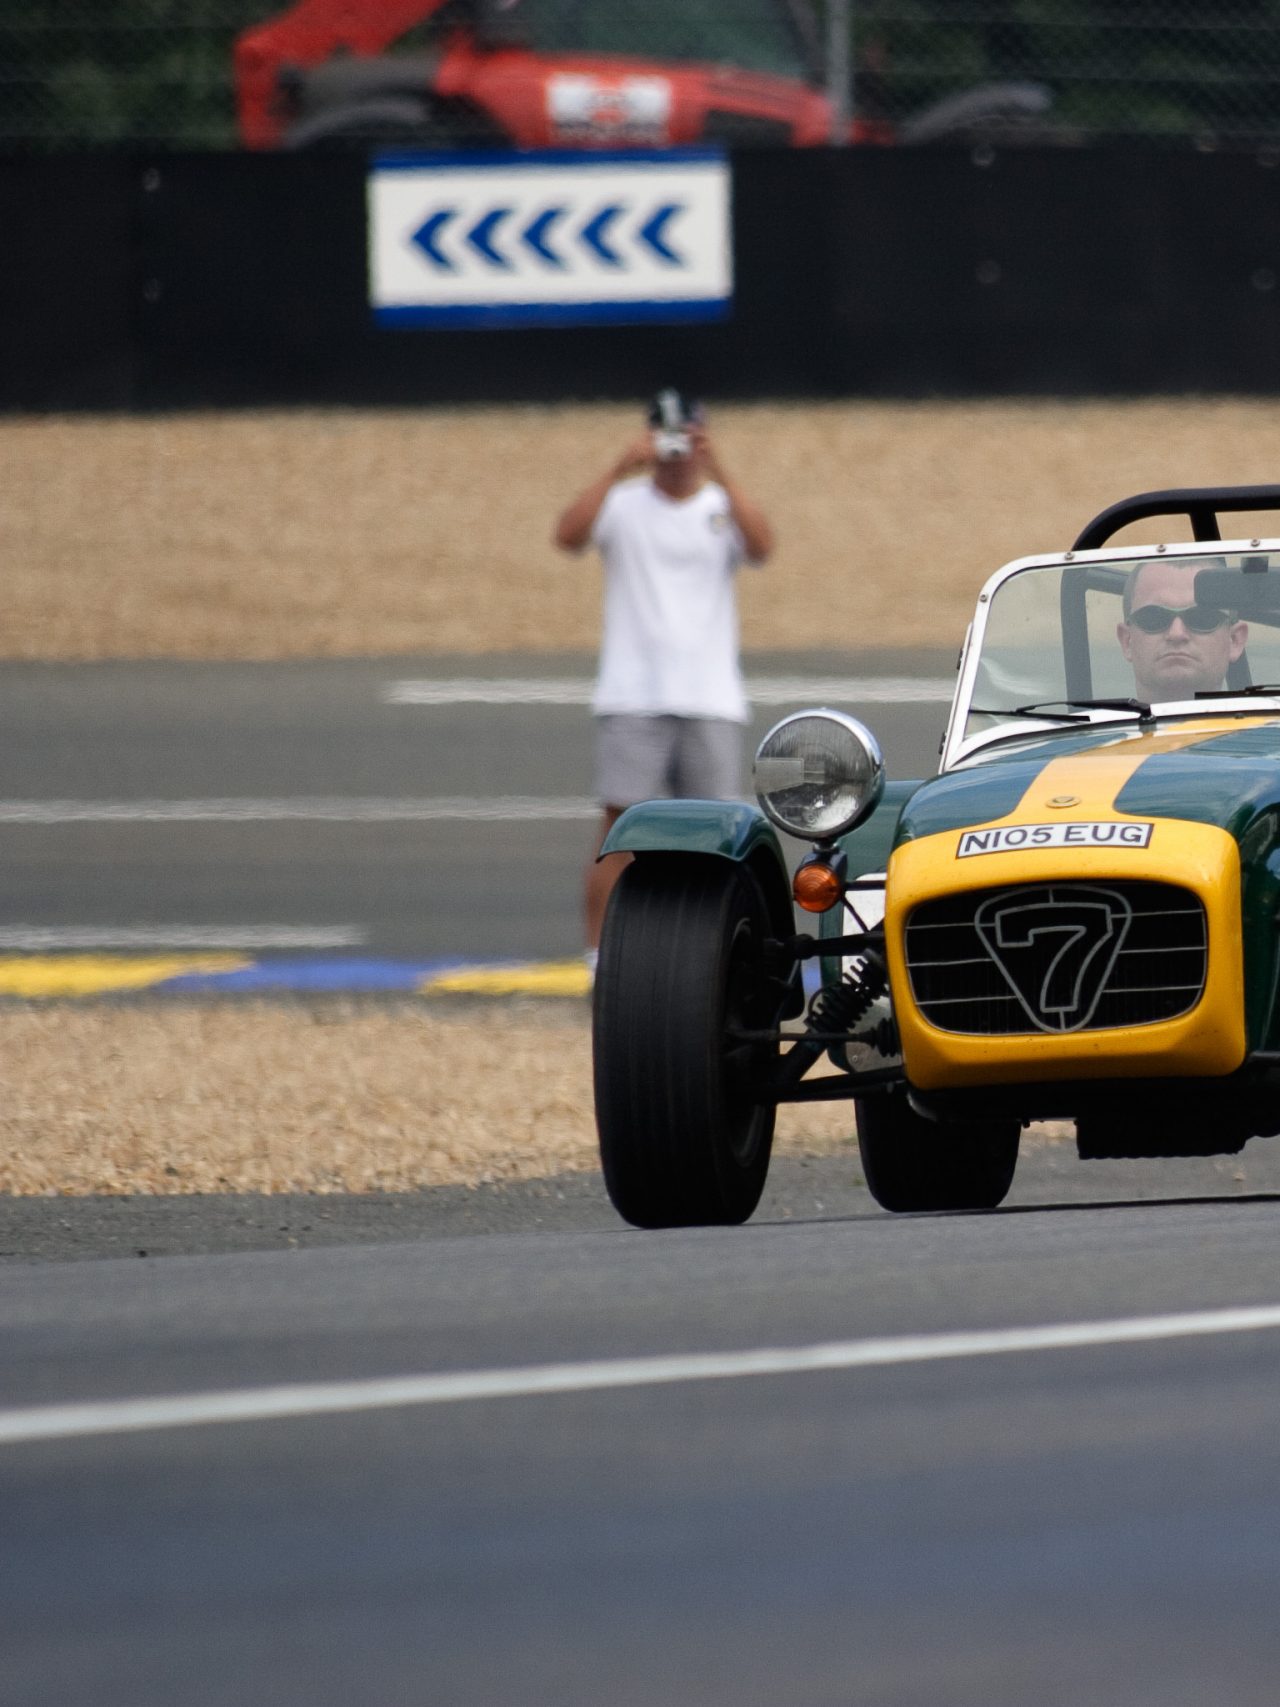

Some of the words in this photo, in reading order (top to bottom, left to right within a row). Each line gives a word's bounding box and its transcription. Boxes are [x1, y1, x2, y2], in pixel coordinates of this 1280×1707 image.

[963, 826, 1053, 853] N105
[1063, 824, 1144, 843] EUG
[995, 902, 1113, 1012] 7
